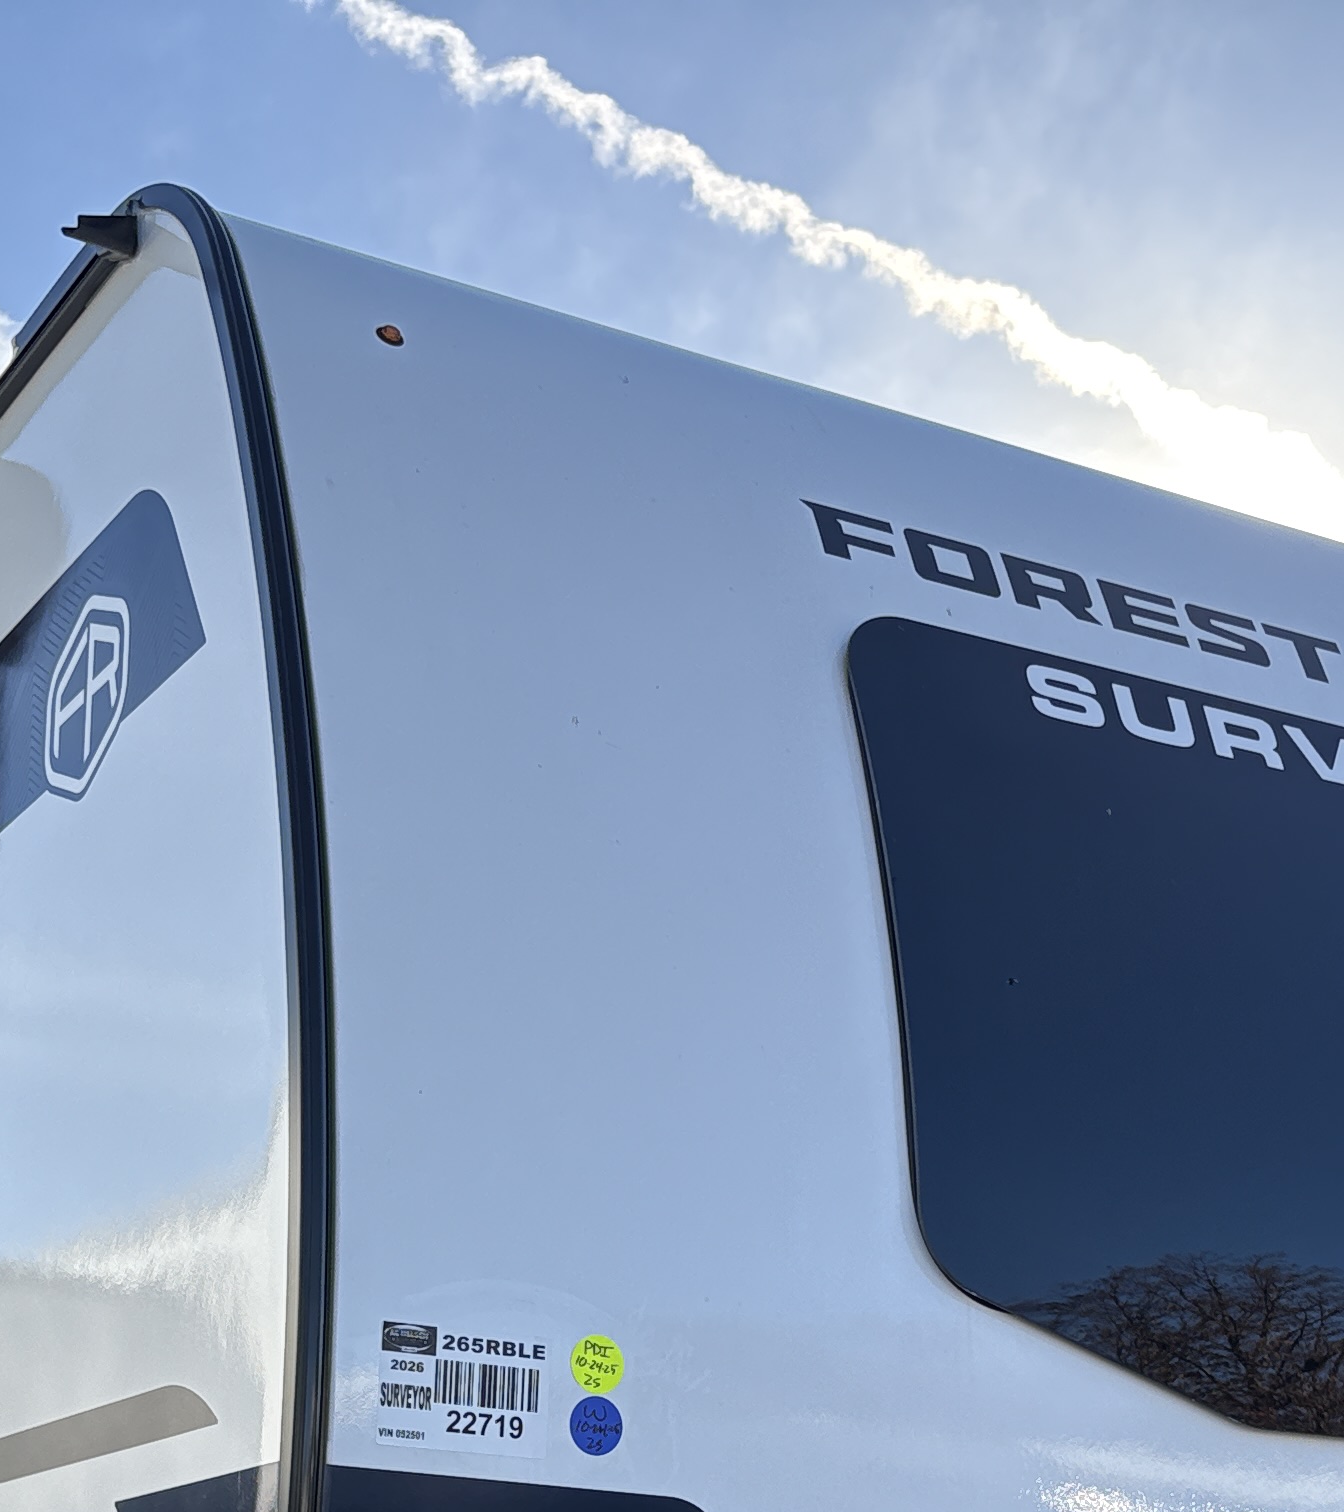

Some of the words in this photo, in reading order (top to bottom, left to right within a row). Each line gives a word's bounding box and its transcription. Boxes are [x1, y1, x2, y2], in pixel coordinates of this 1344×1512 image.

[799, 497, 1341, 684] FOREST
[442, 1334, 546, 1361] 265RBLE
[584, 1340, 615, 1358] PDI
[390, 1359, 425, 1373] 2026
[380, 1382, 432, 1411] SURVEYOR
[378, 1428, 394, 1438] VIN
[445, 1410, 524, 1439] 22719
